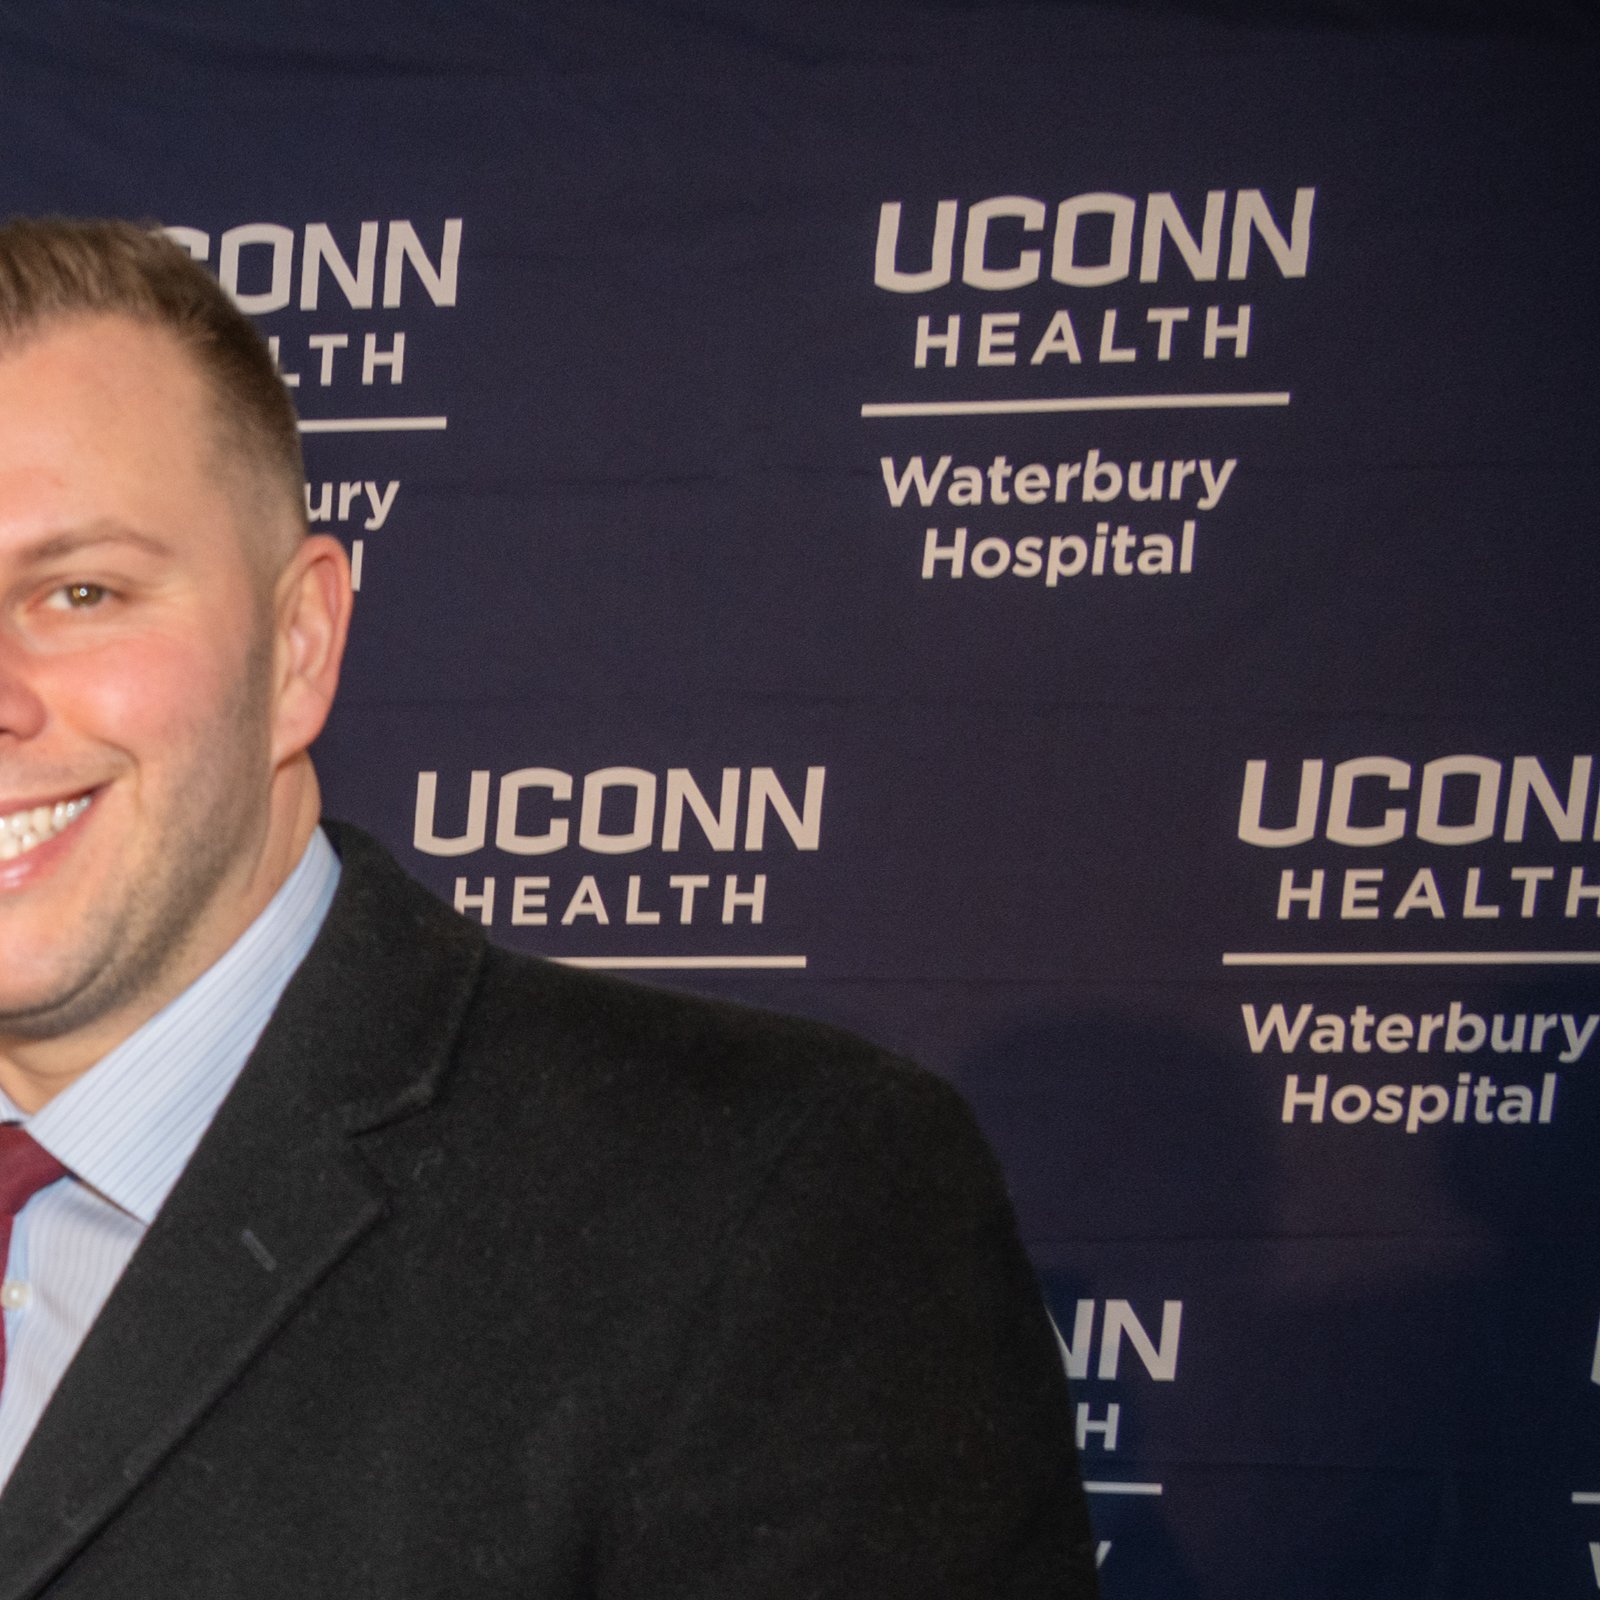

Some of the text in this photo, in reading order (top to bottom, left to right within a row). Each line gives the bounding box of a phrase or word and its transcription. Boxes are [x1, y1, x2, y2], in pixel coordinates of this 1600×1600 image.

[162, 218, 463, 315] ONN
[874, 187, 1316, 293] UCONN
[914, 305, 1252, 369] HEALTH
[880, 449, 1237, 510] Waterbury
[921, 521, 1197, 588] Hospital
[413, 766, 826, 857] UCONN
[1238, 754, 1600, 848] UCON
[453, 874, 767, 926] HEALTH
[1276, 866, 1600, 920] HEALTH
[1241, 1002, 1600, 1063] Waterbury
[1281, 1073, 1557, 1134] Hospital
